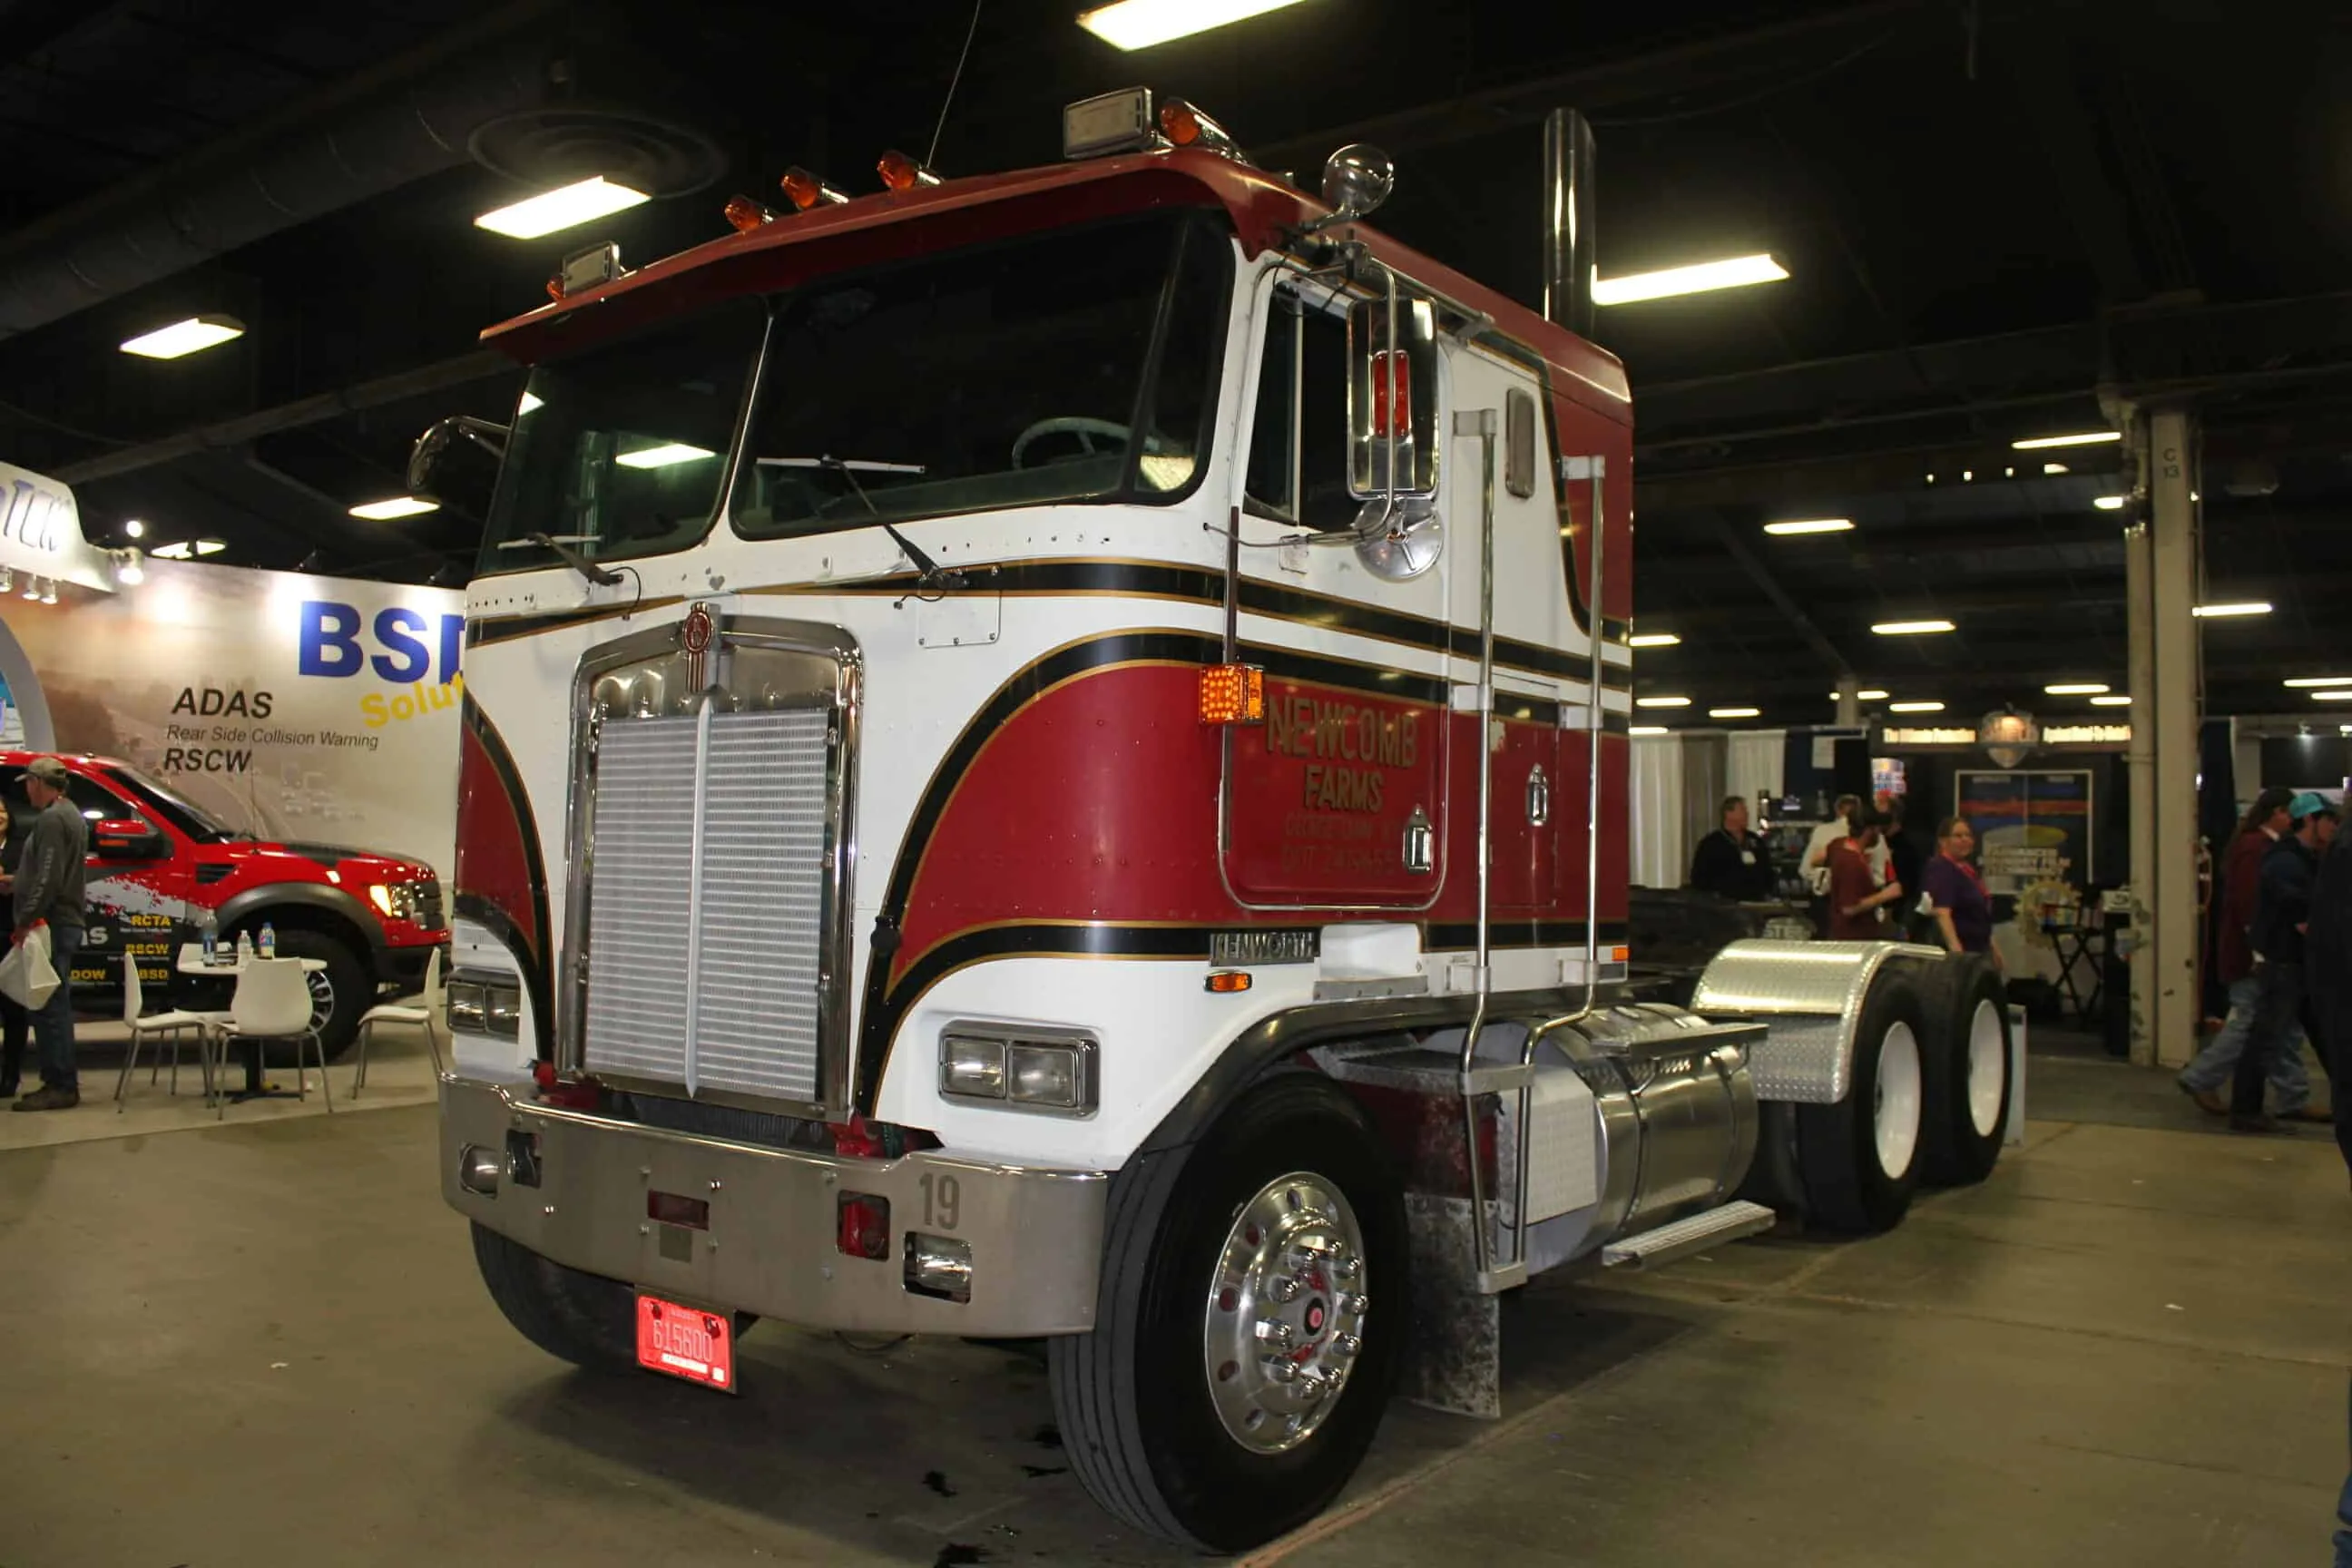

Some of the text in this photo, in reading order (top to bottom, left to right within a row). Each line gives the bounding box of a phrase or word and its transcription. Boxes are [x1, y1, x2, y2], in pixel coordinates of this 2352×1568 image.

[172, 687, 273, 719] ADAS
[166, 724, 378, 751] Rear Side Collision Warning
[1267, 696, 1418, 769] NEWCOMB
[163, 747, 252, 773] RSCW
[1304, 765, 1384, 813] FARMS
[130, 914, 172, 927] RCTA
[918, 1172, 960, 1230] 19
